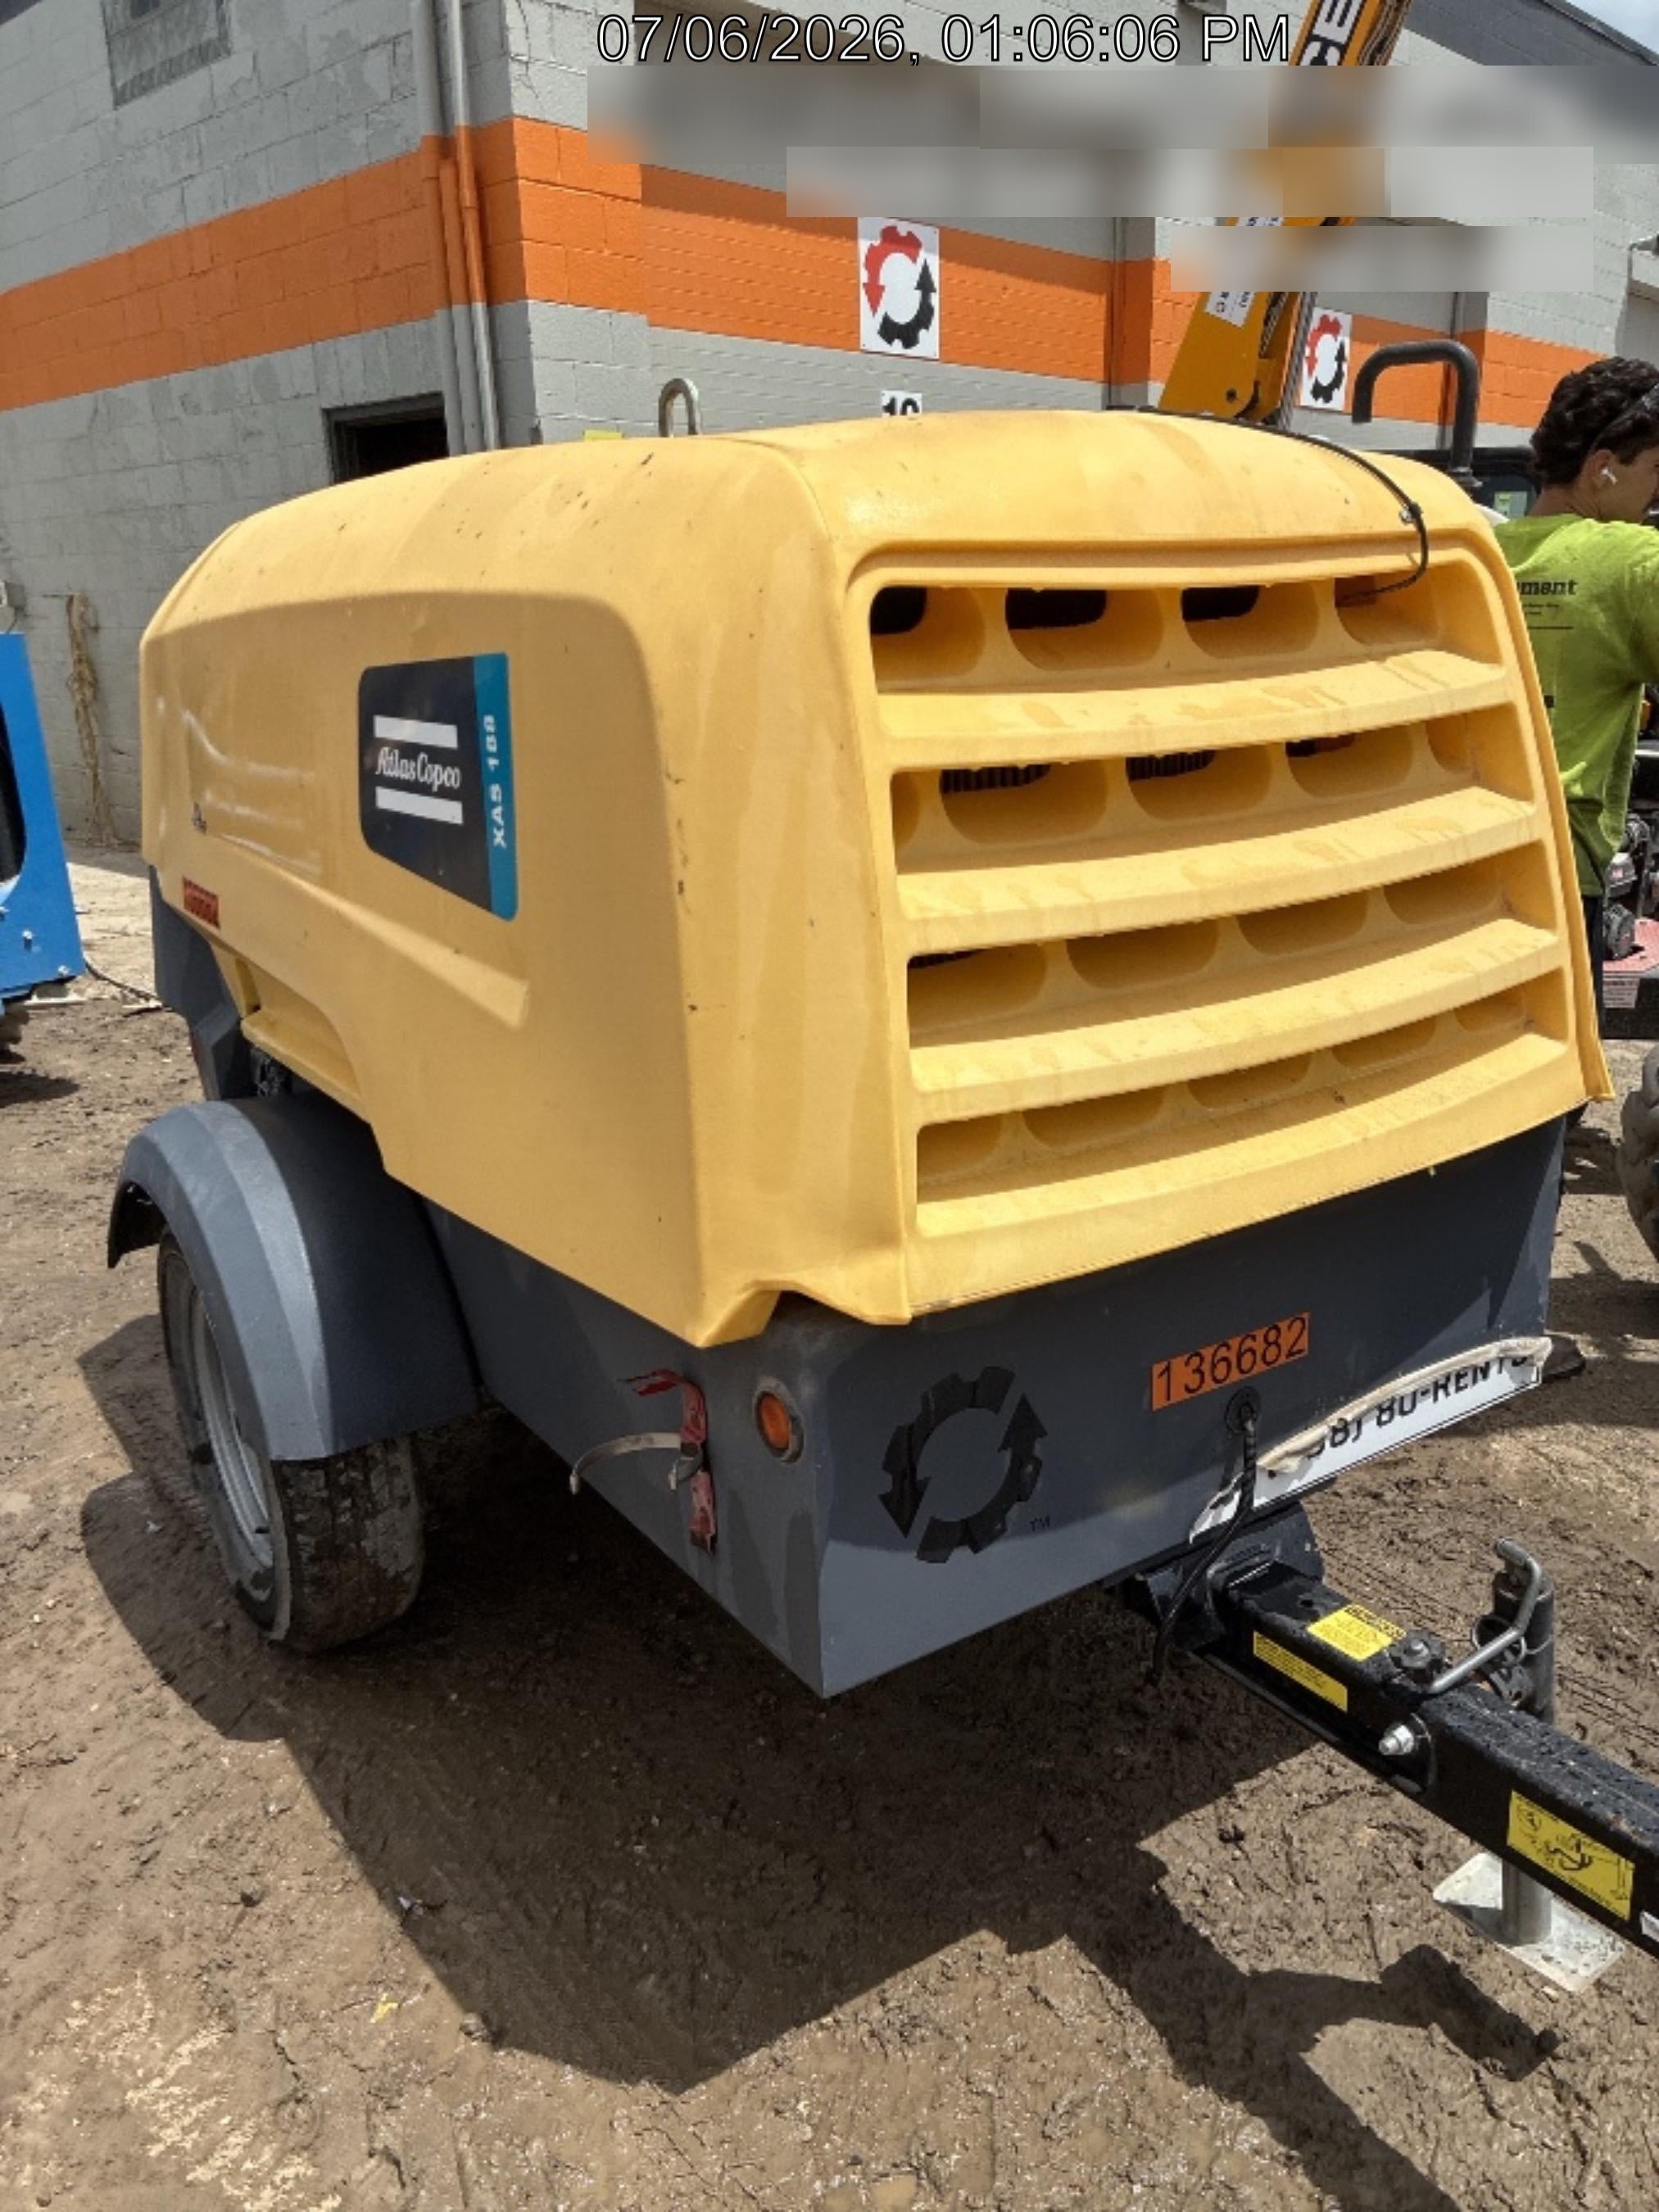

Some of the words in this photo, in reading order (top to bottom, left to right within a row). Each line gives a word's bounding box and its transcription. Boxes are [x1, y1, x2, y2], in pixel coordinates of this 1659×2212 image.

[1516, 579, 1579, 596] ment
[375, 746, 416, 782] Atlas
[417, 751, 461, 792] Copco
[489, 783, 507, 849] XAS
[1156, 1316, 1307, 1402] 136682
